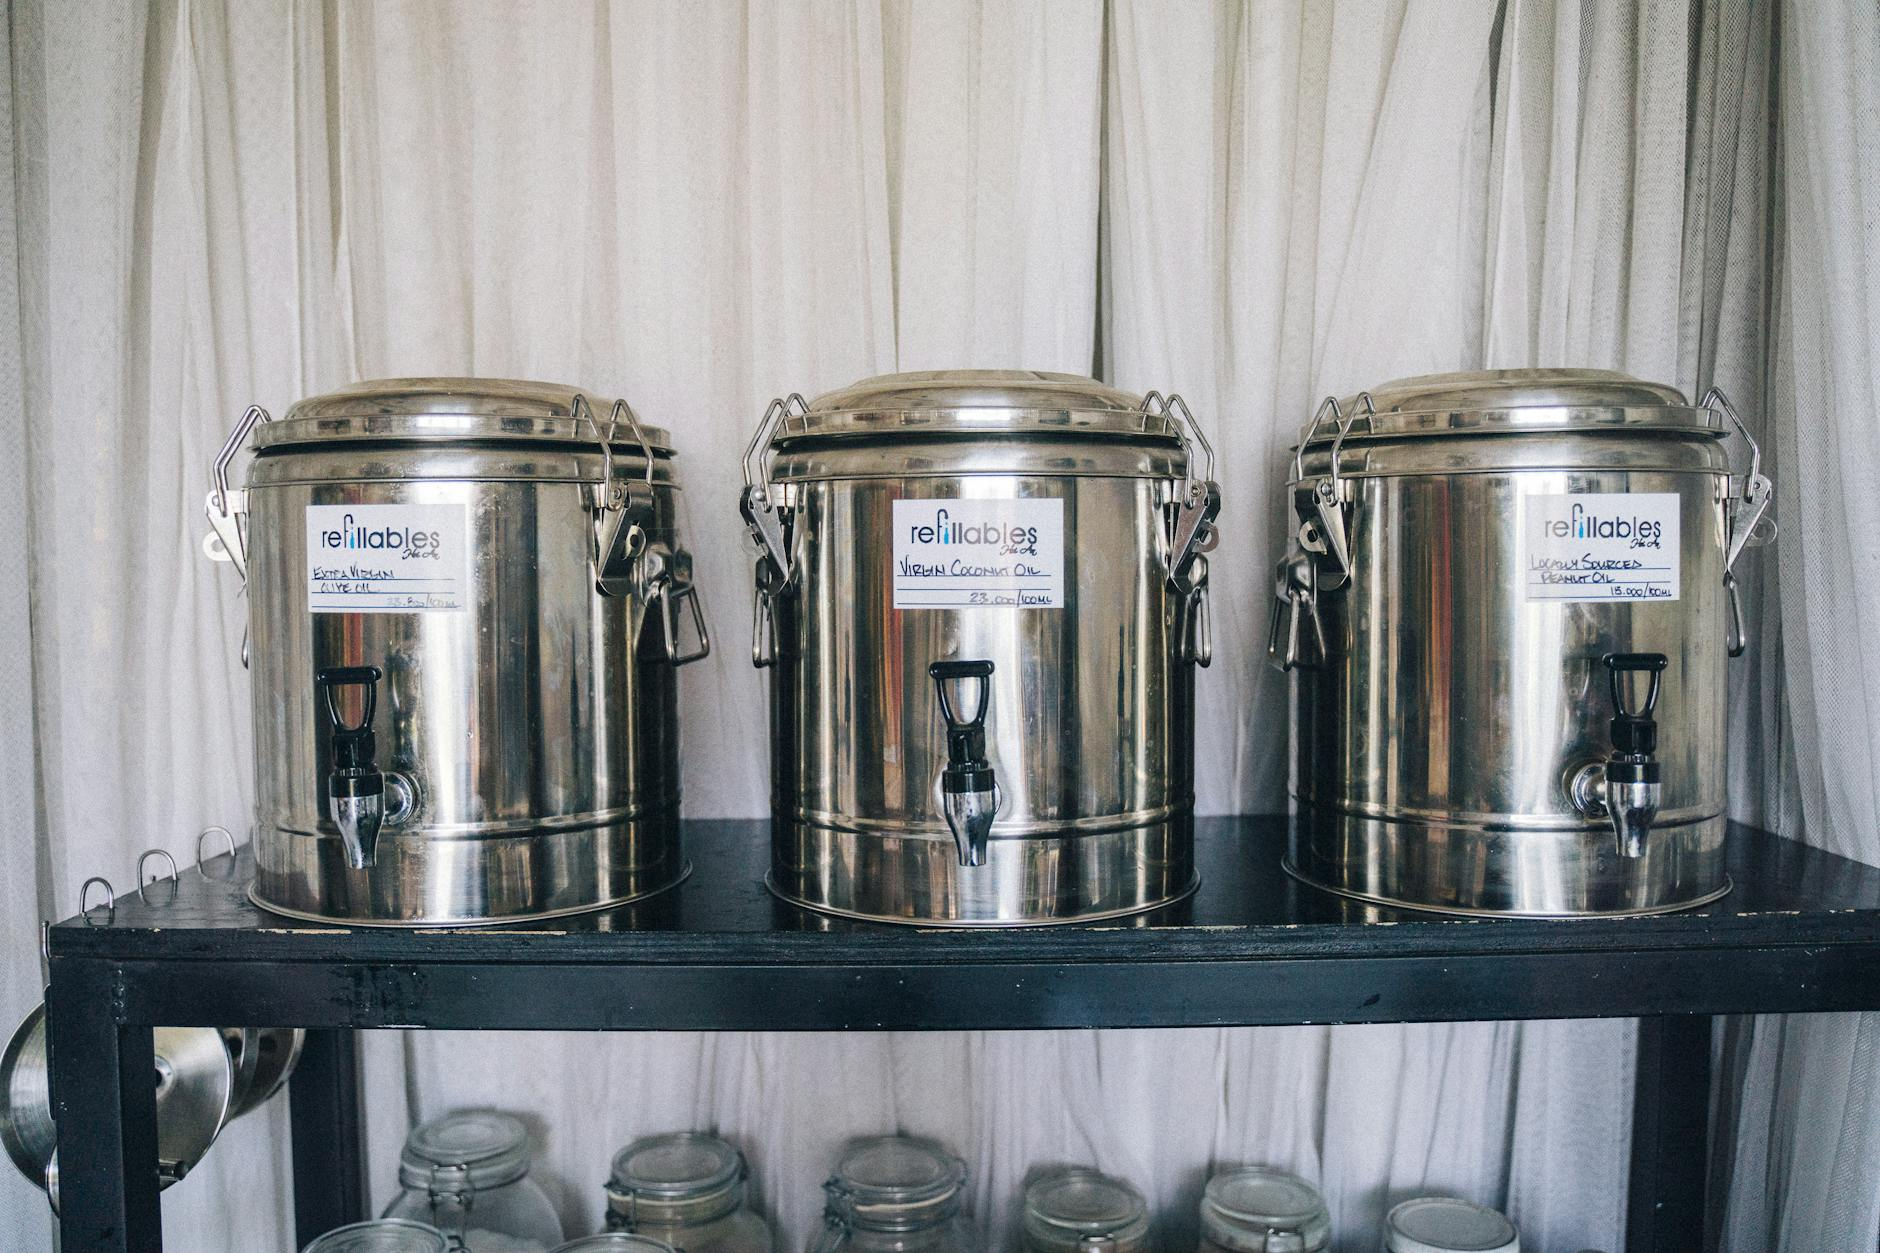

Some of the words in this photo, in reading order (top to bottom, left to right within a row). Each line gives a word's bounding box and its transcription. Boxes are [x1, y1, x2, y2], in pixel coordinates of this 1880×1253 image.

[322, 514, 440, 549] refillables
[911, 509, 1038, 545] refillables
[1544, 503, 1661, 539] refillables
[900, 554, 945, 577] VIRGIN
[950, 559, 1009, 577] COCONUT
[1014, 563, 1041, 576] OIL
[1581, 552, 1643, 570] SOURCED
[1541, 571, 1591, 584] PEANUT
[1592, 571, 1616, 584] OIL
